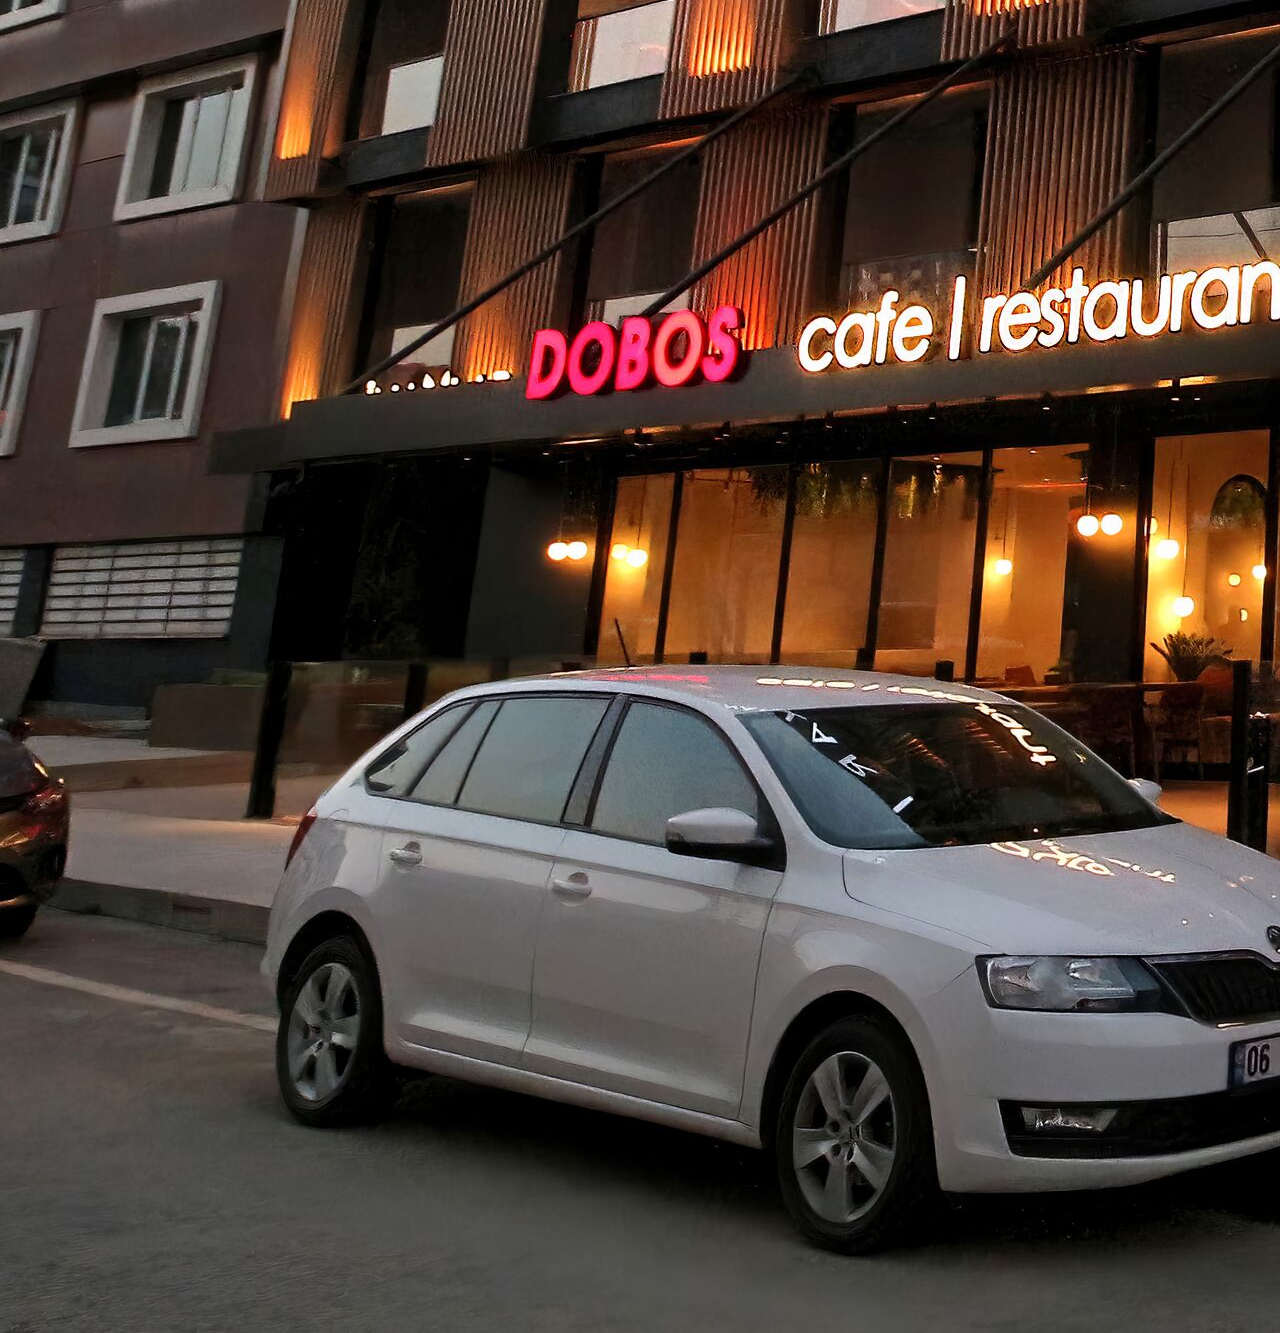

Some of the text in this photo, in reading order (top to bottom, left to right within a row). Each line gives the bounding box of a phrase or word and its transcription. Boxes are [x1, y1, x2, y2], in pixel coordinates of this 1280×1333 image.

[523, 303, 745, 403] DOBOS
[797, 289, 933, 373] cafe
[1247, 1043, 1270, 1077] 06
